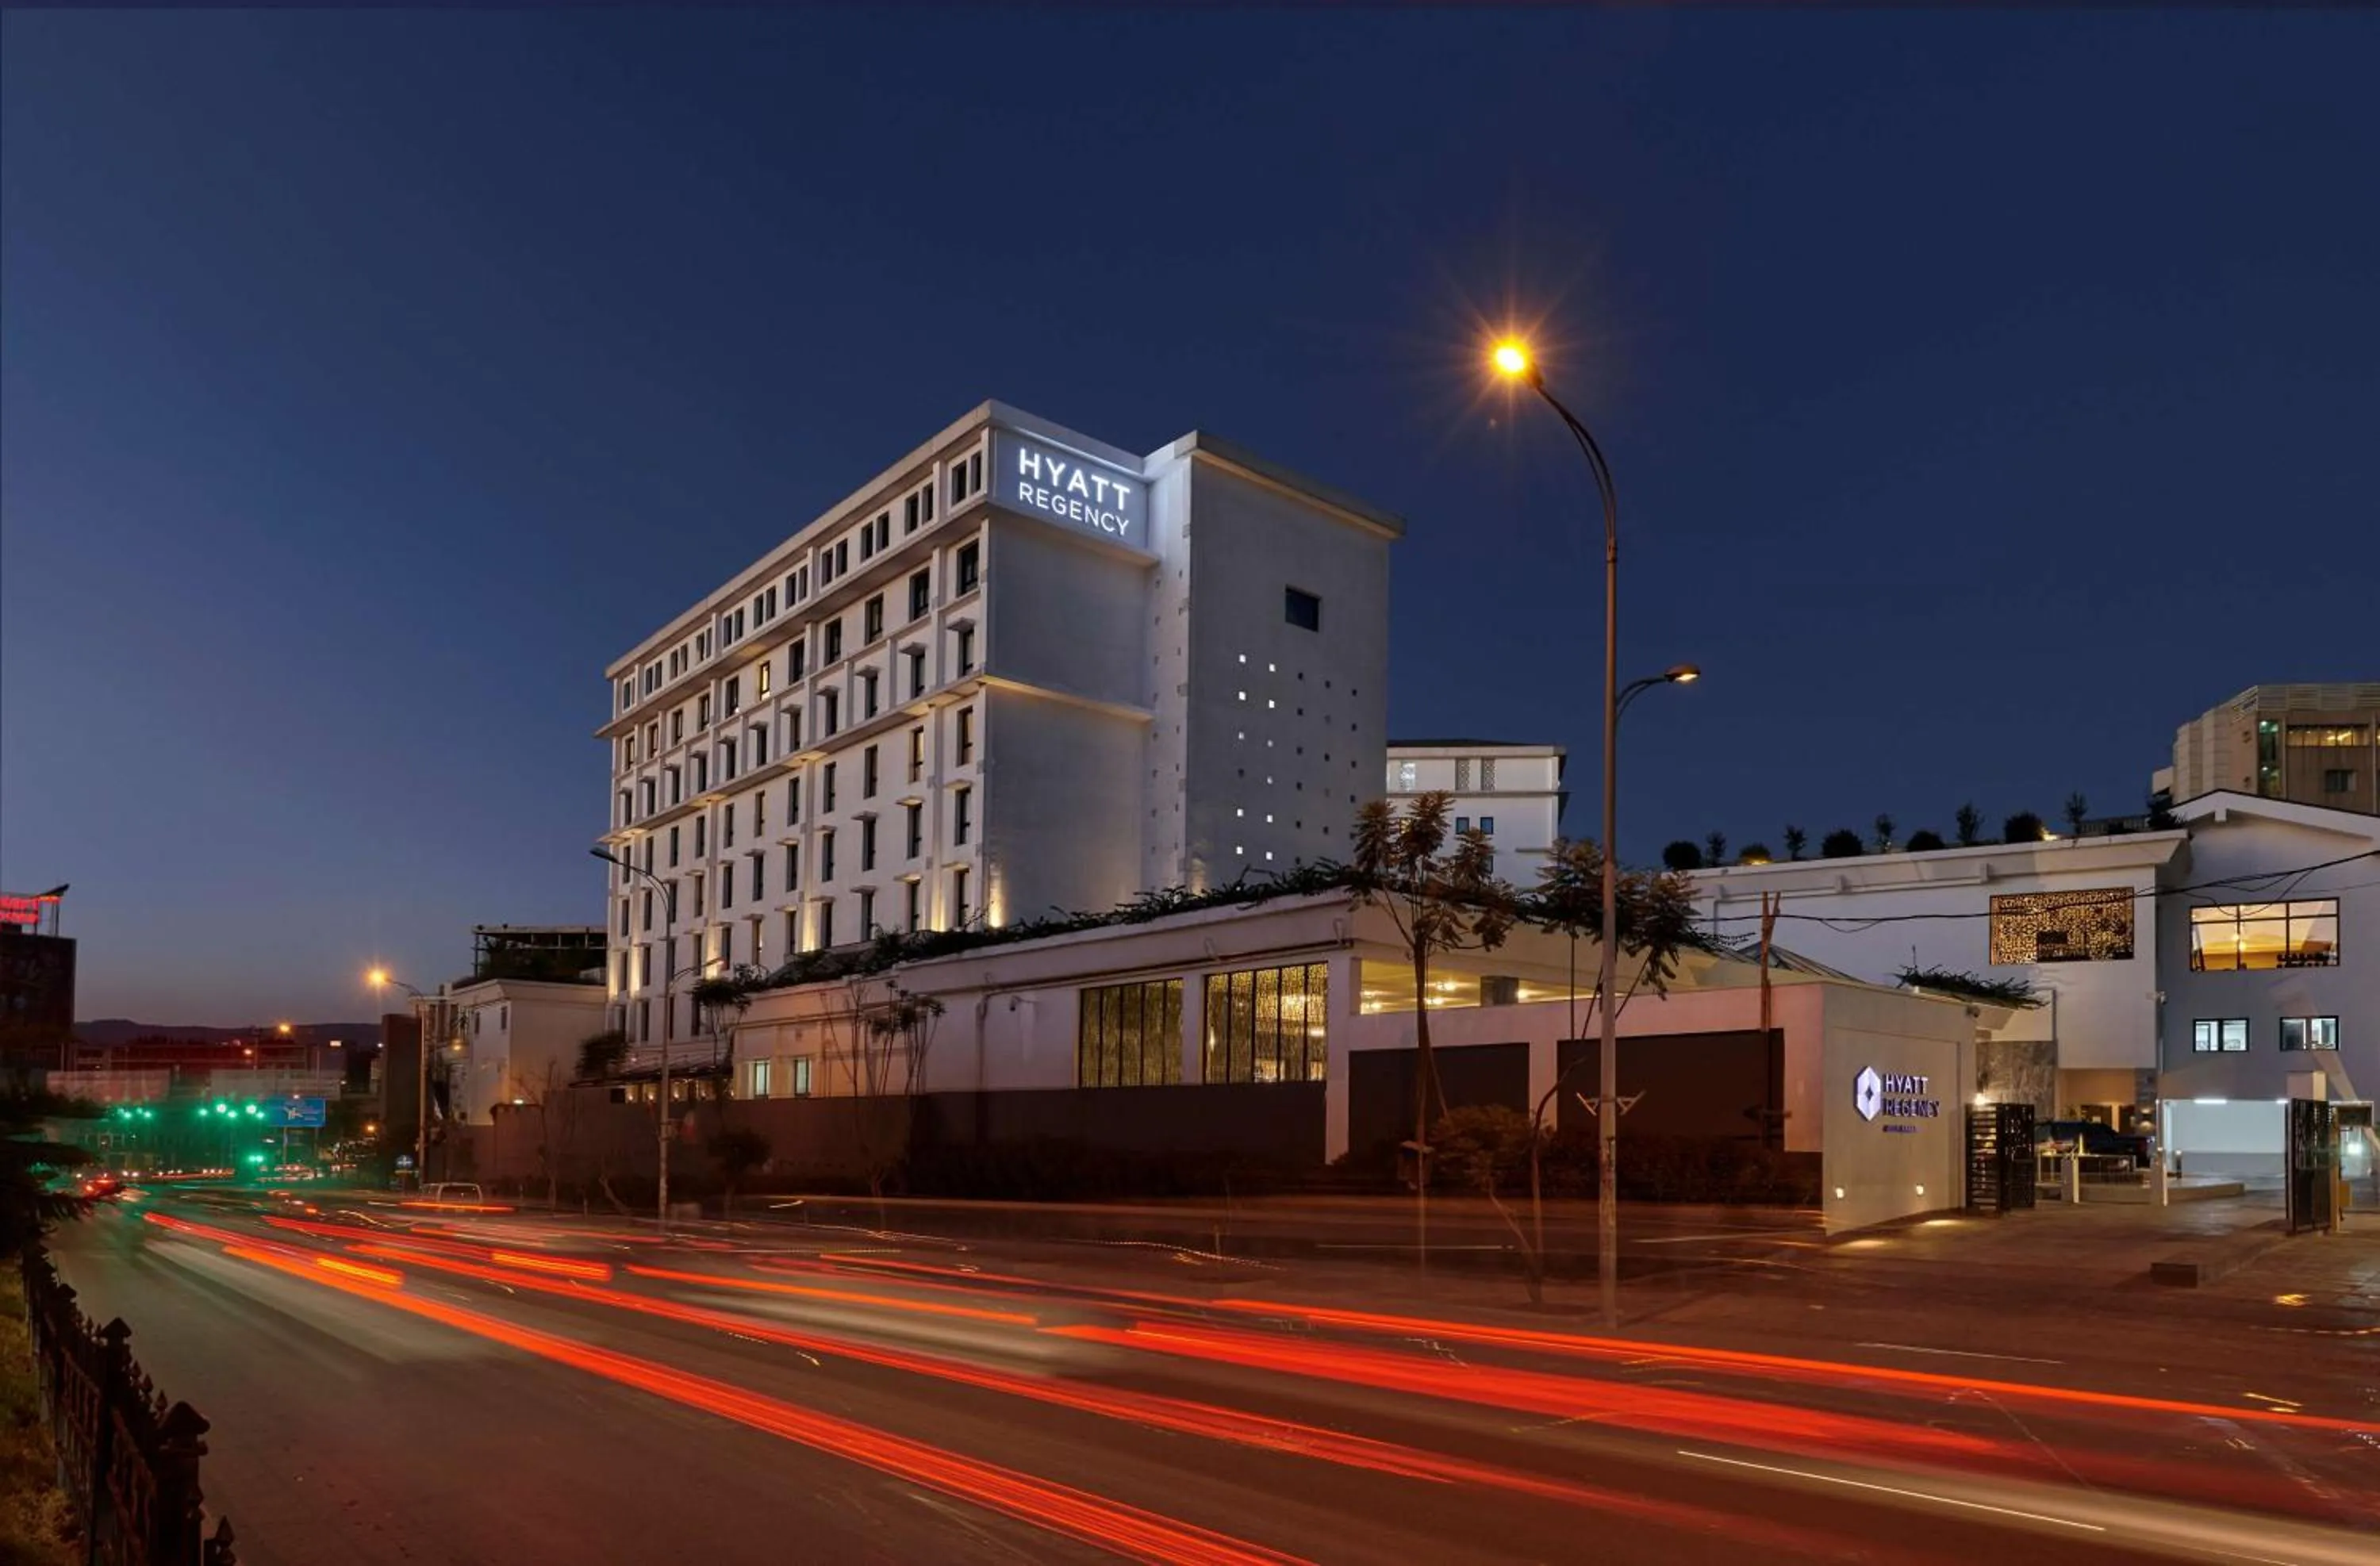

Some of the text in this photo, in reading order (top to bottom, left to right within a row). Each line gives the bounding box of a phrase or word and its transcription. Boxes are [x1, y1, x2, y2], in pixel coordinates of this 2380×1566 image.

[1019, 447, 1130, 511] HYATT
[1019, 482, 1130, 536] REGENCY
[1883, 1073, 1929, 1095] HYATT
